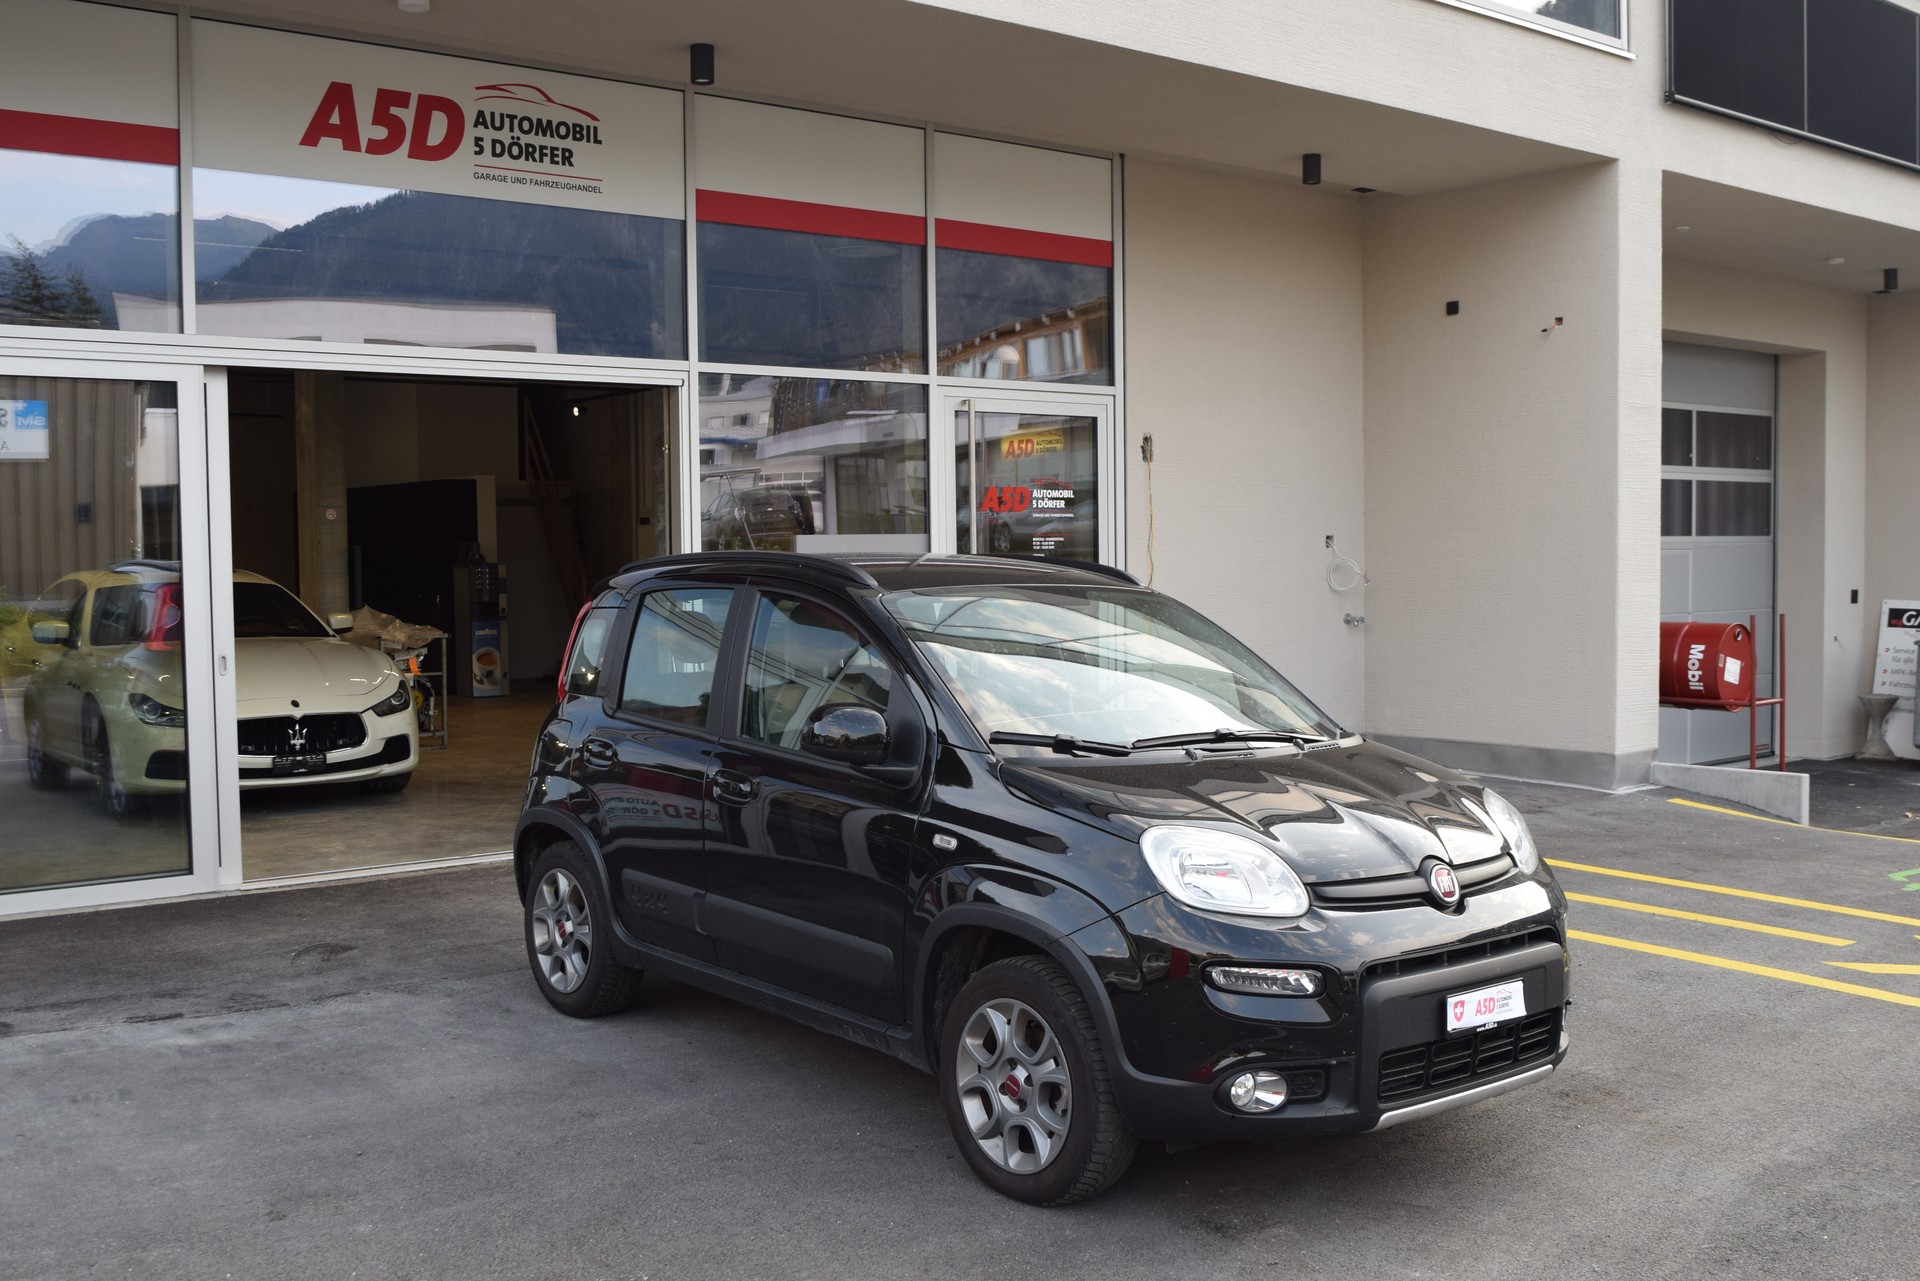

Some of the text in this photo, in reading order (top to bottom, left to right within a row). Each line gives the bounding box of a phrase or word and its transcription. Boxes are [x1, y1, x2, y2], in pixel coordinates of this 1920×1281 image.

[298, 81, 465, 162] A5D
[473, 109, 602, 145] AUTOMOBIL
[473, 135, 574, 167] 5 DÖRFER
[473, 172, 603, 194] GARAGE UND FAHRZEUGHANDEL
[1005, 438, 1035, 458] A5D
[980, 485, 1031, 513] A5D
[1032, 489, 1074, 498] AUTOMOBIL
[1032, 498, 1065, 509] 5 DÖRFER
[1687, 644, 1706, 690] Mobil
[1437, 875, 1456, 893] FIAT
[1475, 997, 1496, 1017] A5D
